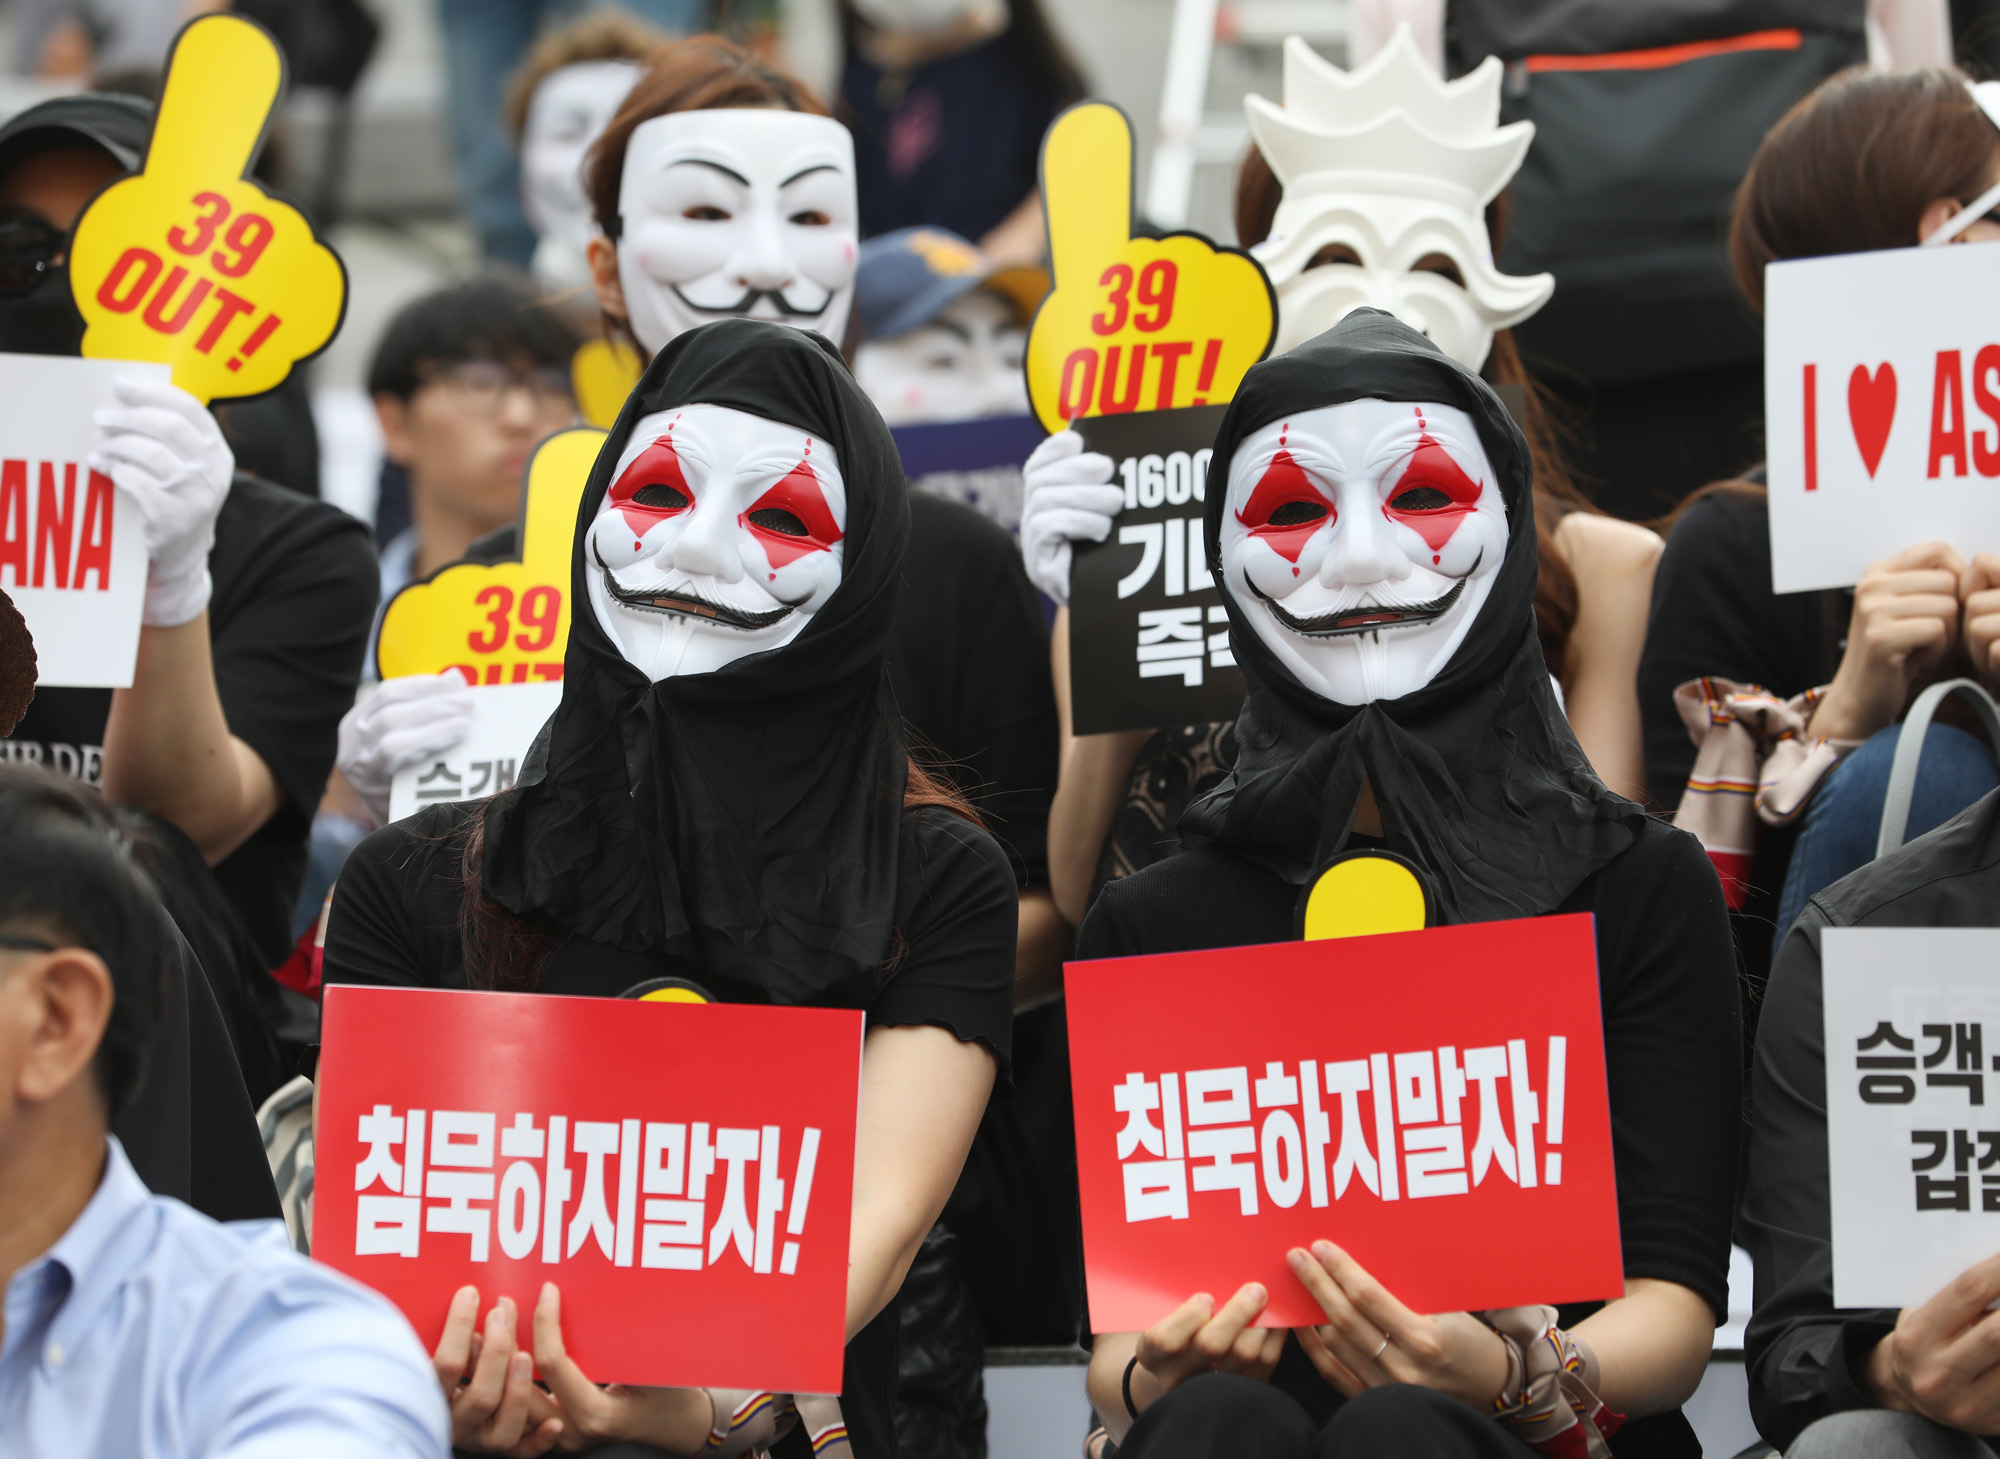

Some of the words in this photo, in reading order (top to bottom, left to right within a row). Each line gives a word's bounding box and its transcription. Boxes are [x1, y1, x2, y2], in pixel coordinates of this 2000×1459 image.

[166, 191, 275, 279] 39
[96, 246, 283, 374] OUT!
[1091, 259, 1179, 337] 39
[1058, 338, 1224, 421] OUT!
[1803, 364, 1818, 492] I
[0, 459, 114, 591] ANA
[467, 585, 562, 655] 39
